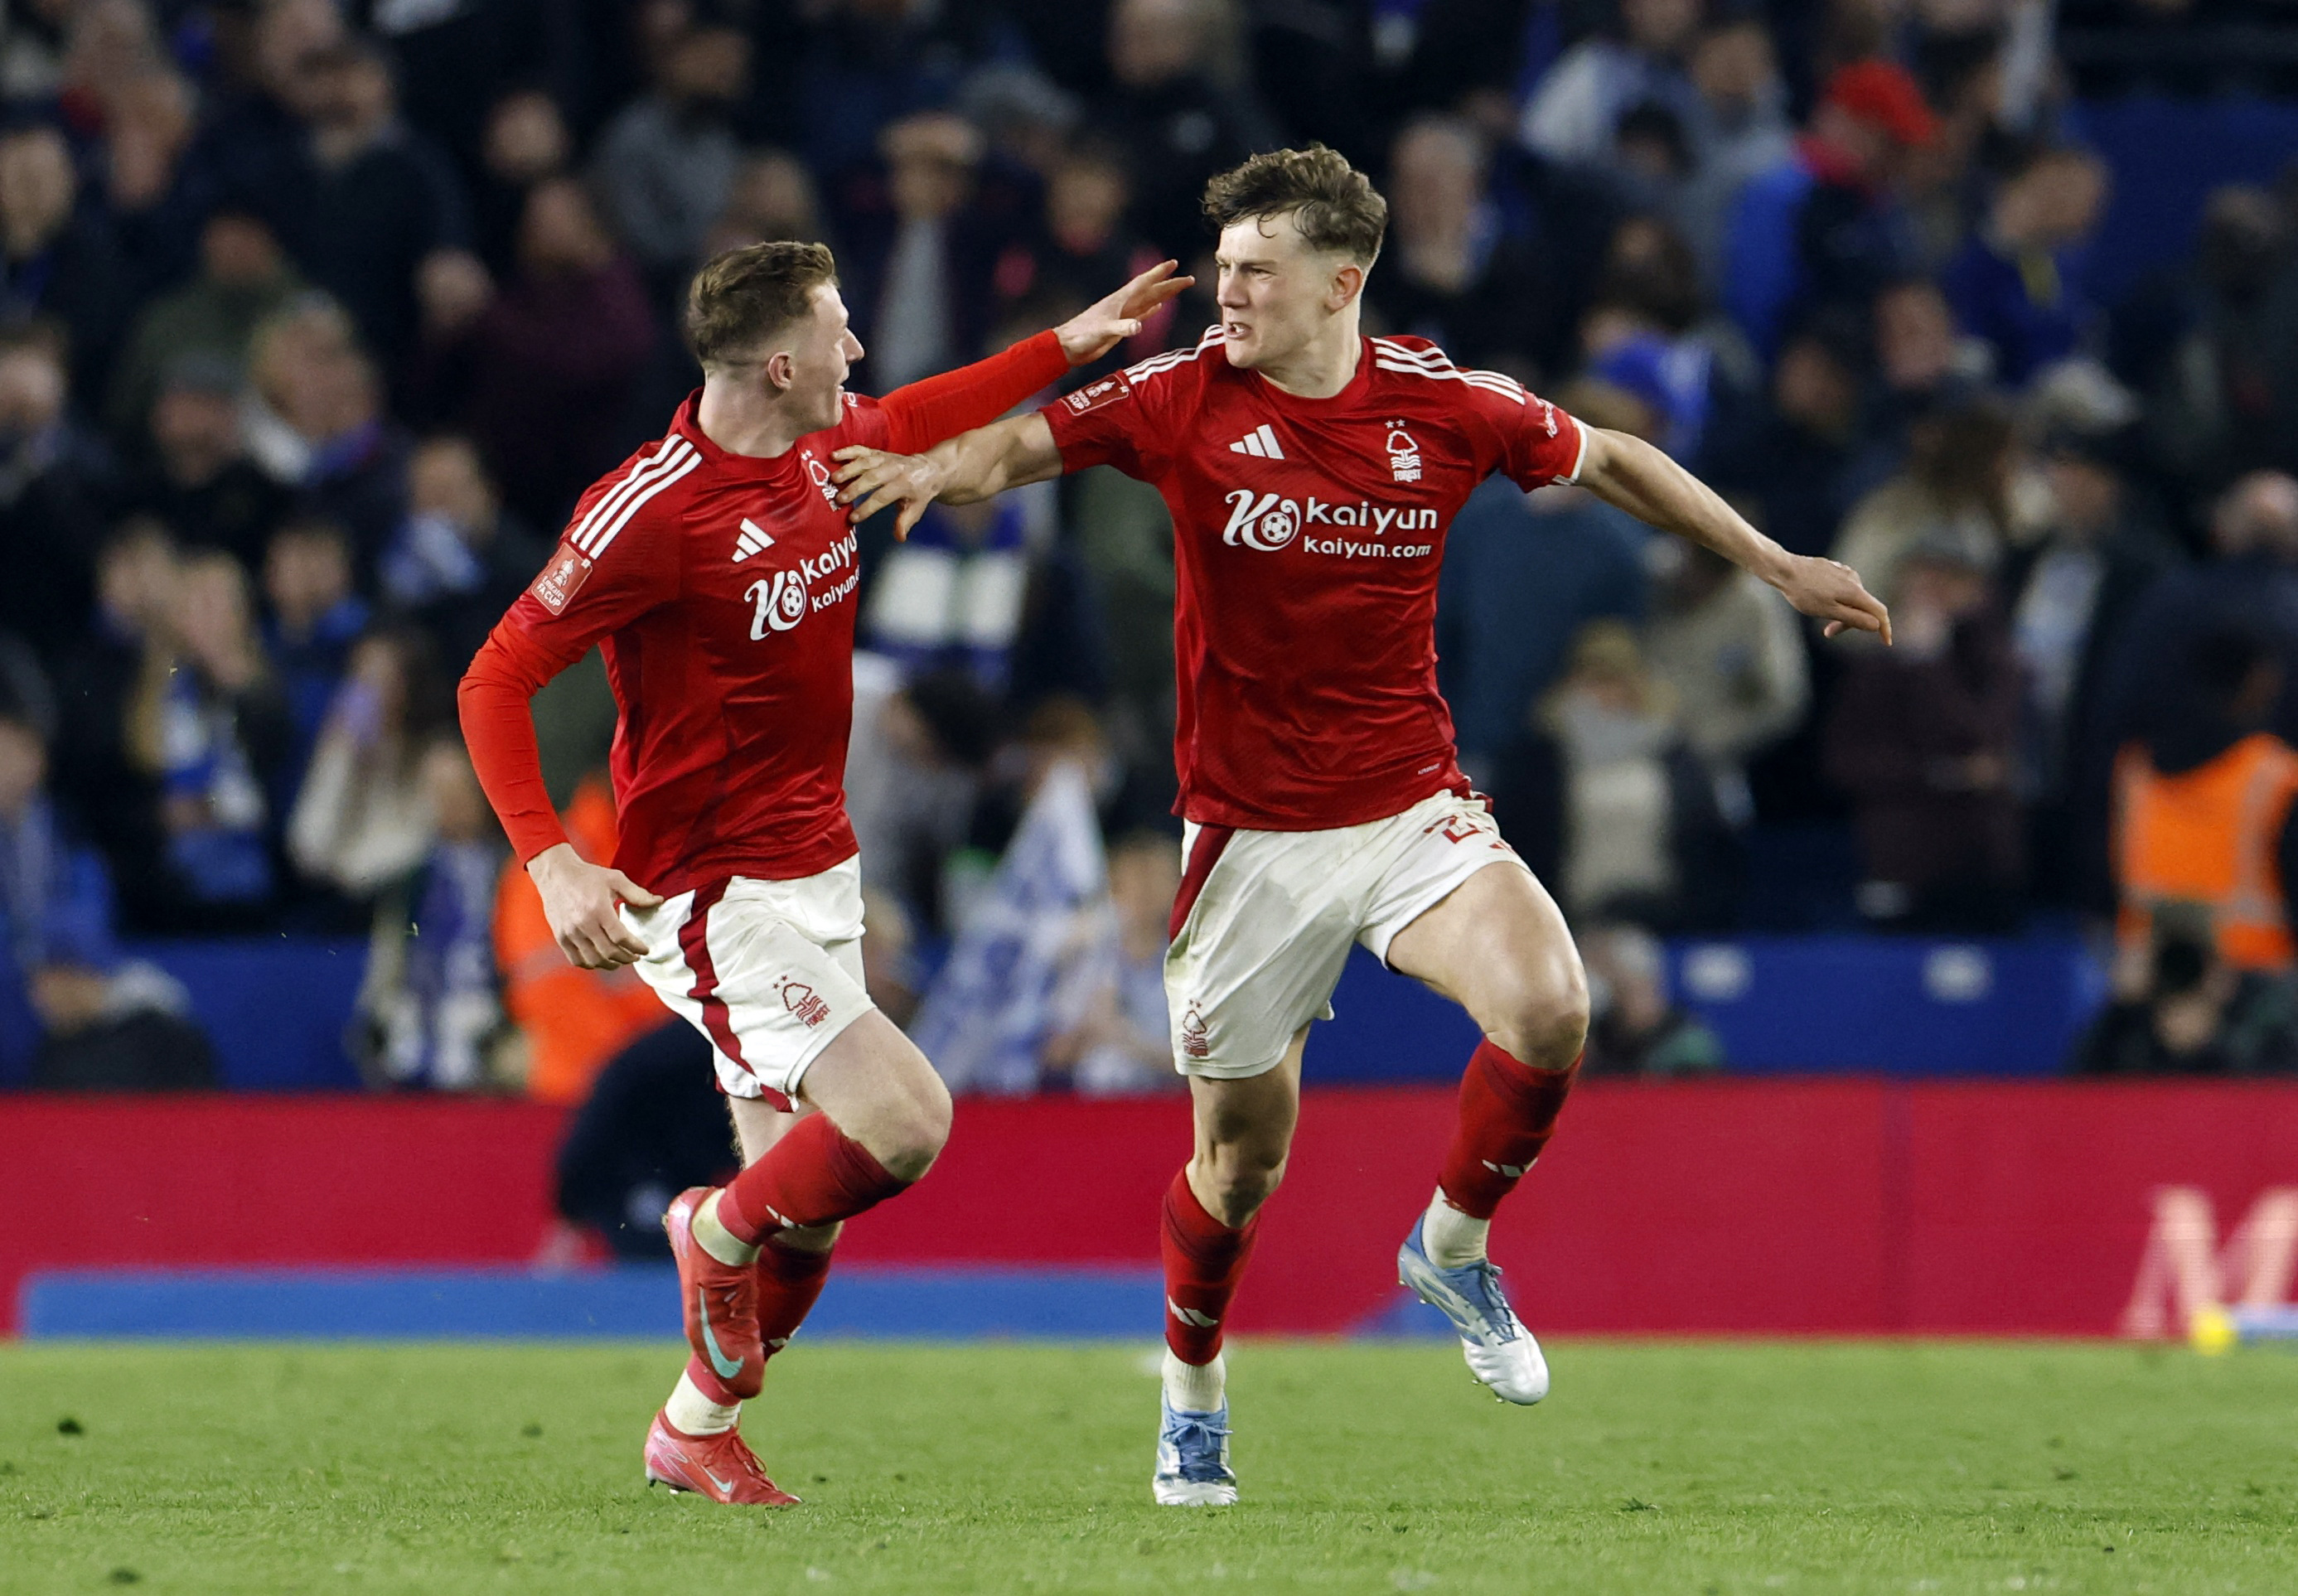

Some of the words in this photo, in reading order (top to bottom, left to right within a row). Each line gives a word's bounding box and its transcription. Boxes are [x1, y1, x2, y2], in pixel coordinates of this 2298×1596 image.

[1305, 497, 1438, 535] kaiyun
[799, 525, 858, 585] kaiyu
[1304, 535, 1432, 559] kaiyun.com
[536, 583, 547, 596] FA
[544, 591, 562, 607] CUP
[811, 564, 860, 613] kaiyun
